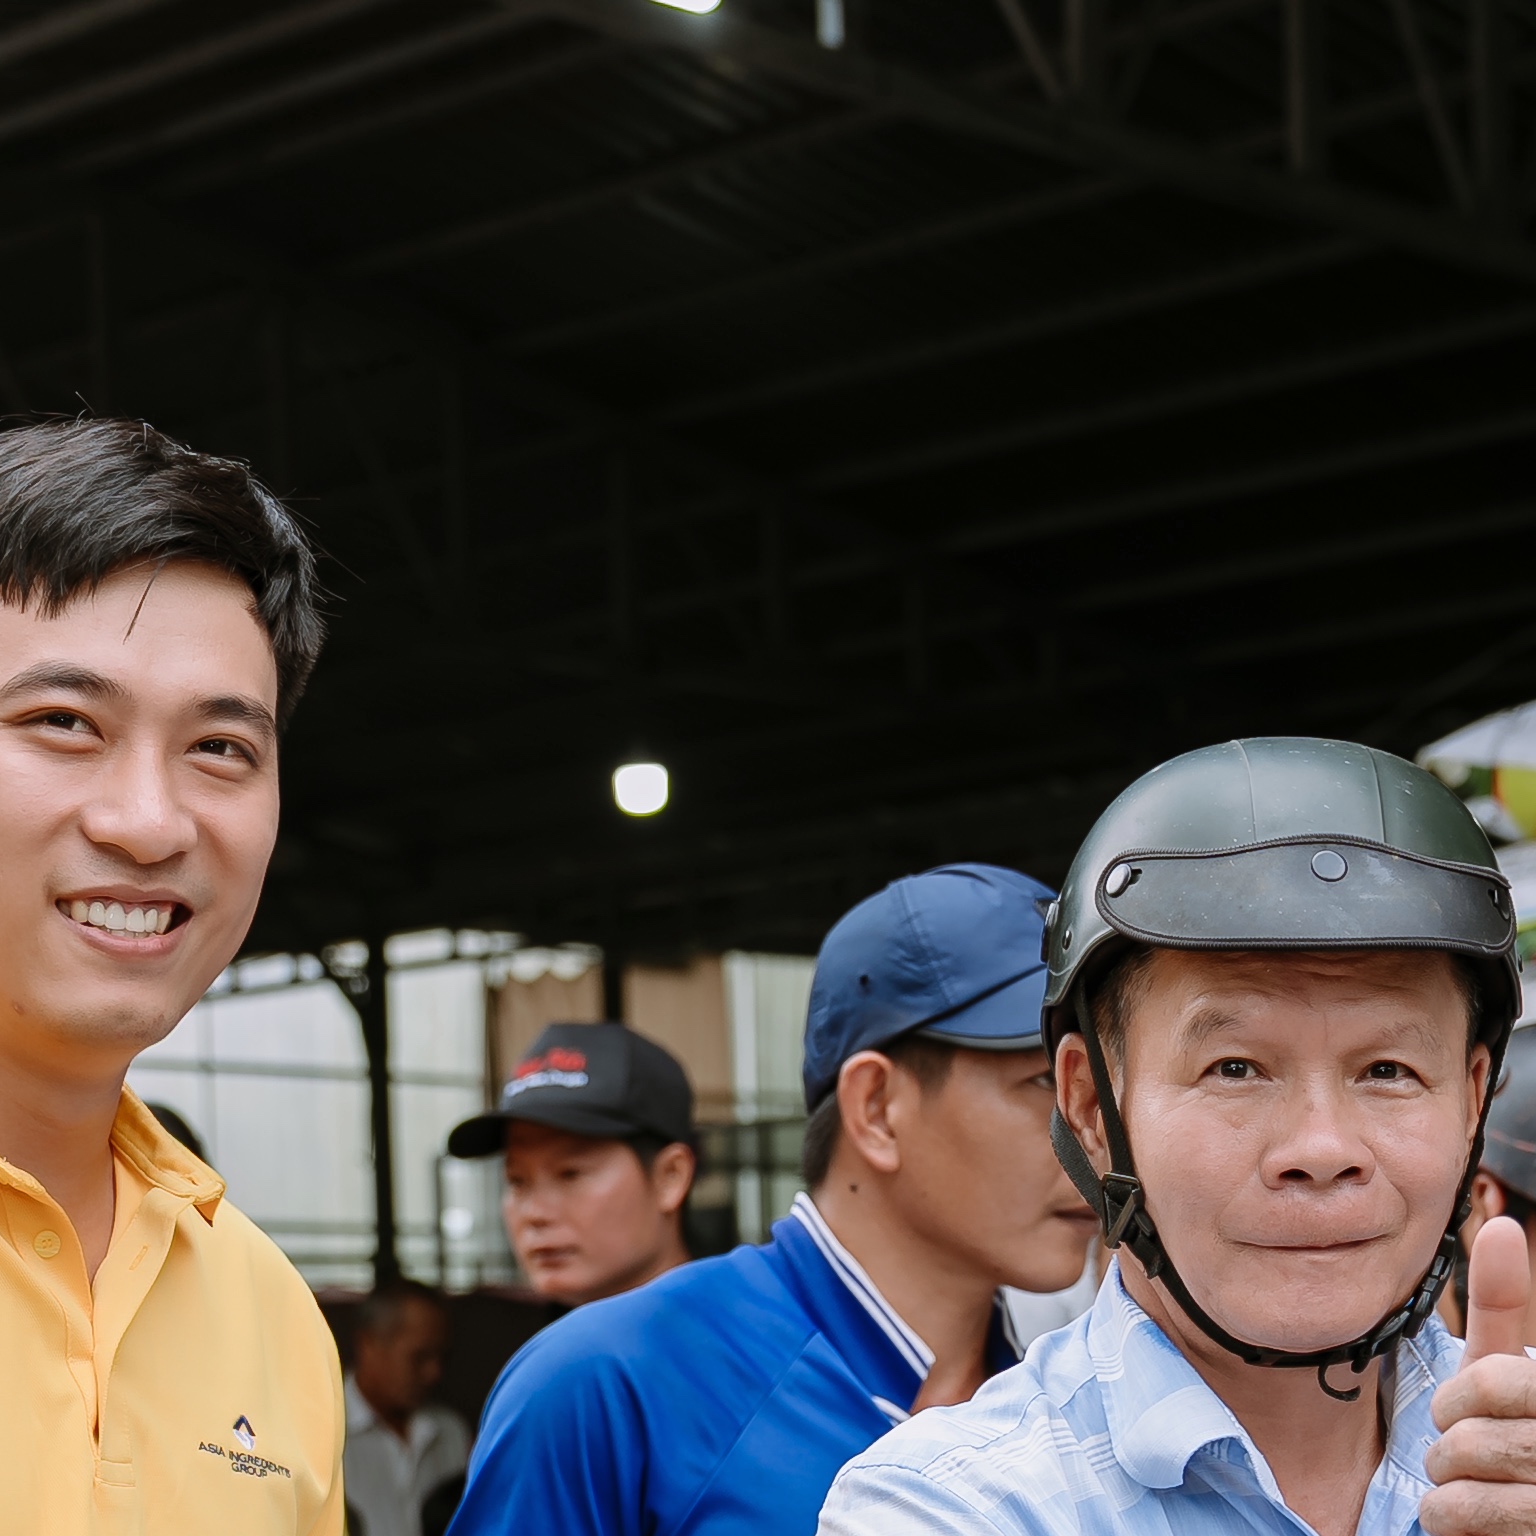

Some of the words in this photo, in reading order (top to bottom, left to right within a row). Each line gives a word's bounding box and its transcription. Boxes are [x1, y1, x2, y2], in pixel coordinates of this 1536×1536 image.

[198, 1441, 226, 1458] ASIA
[228, 1449, 292, 1479] INGREDIENTS
[231, 1462, 268, 1478] GROUP
